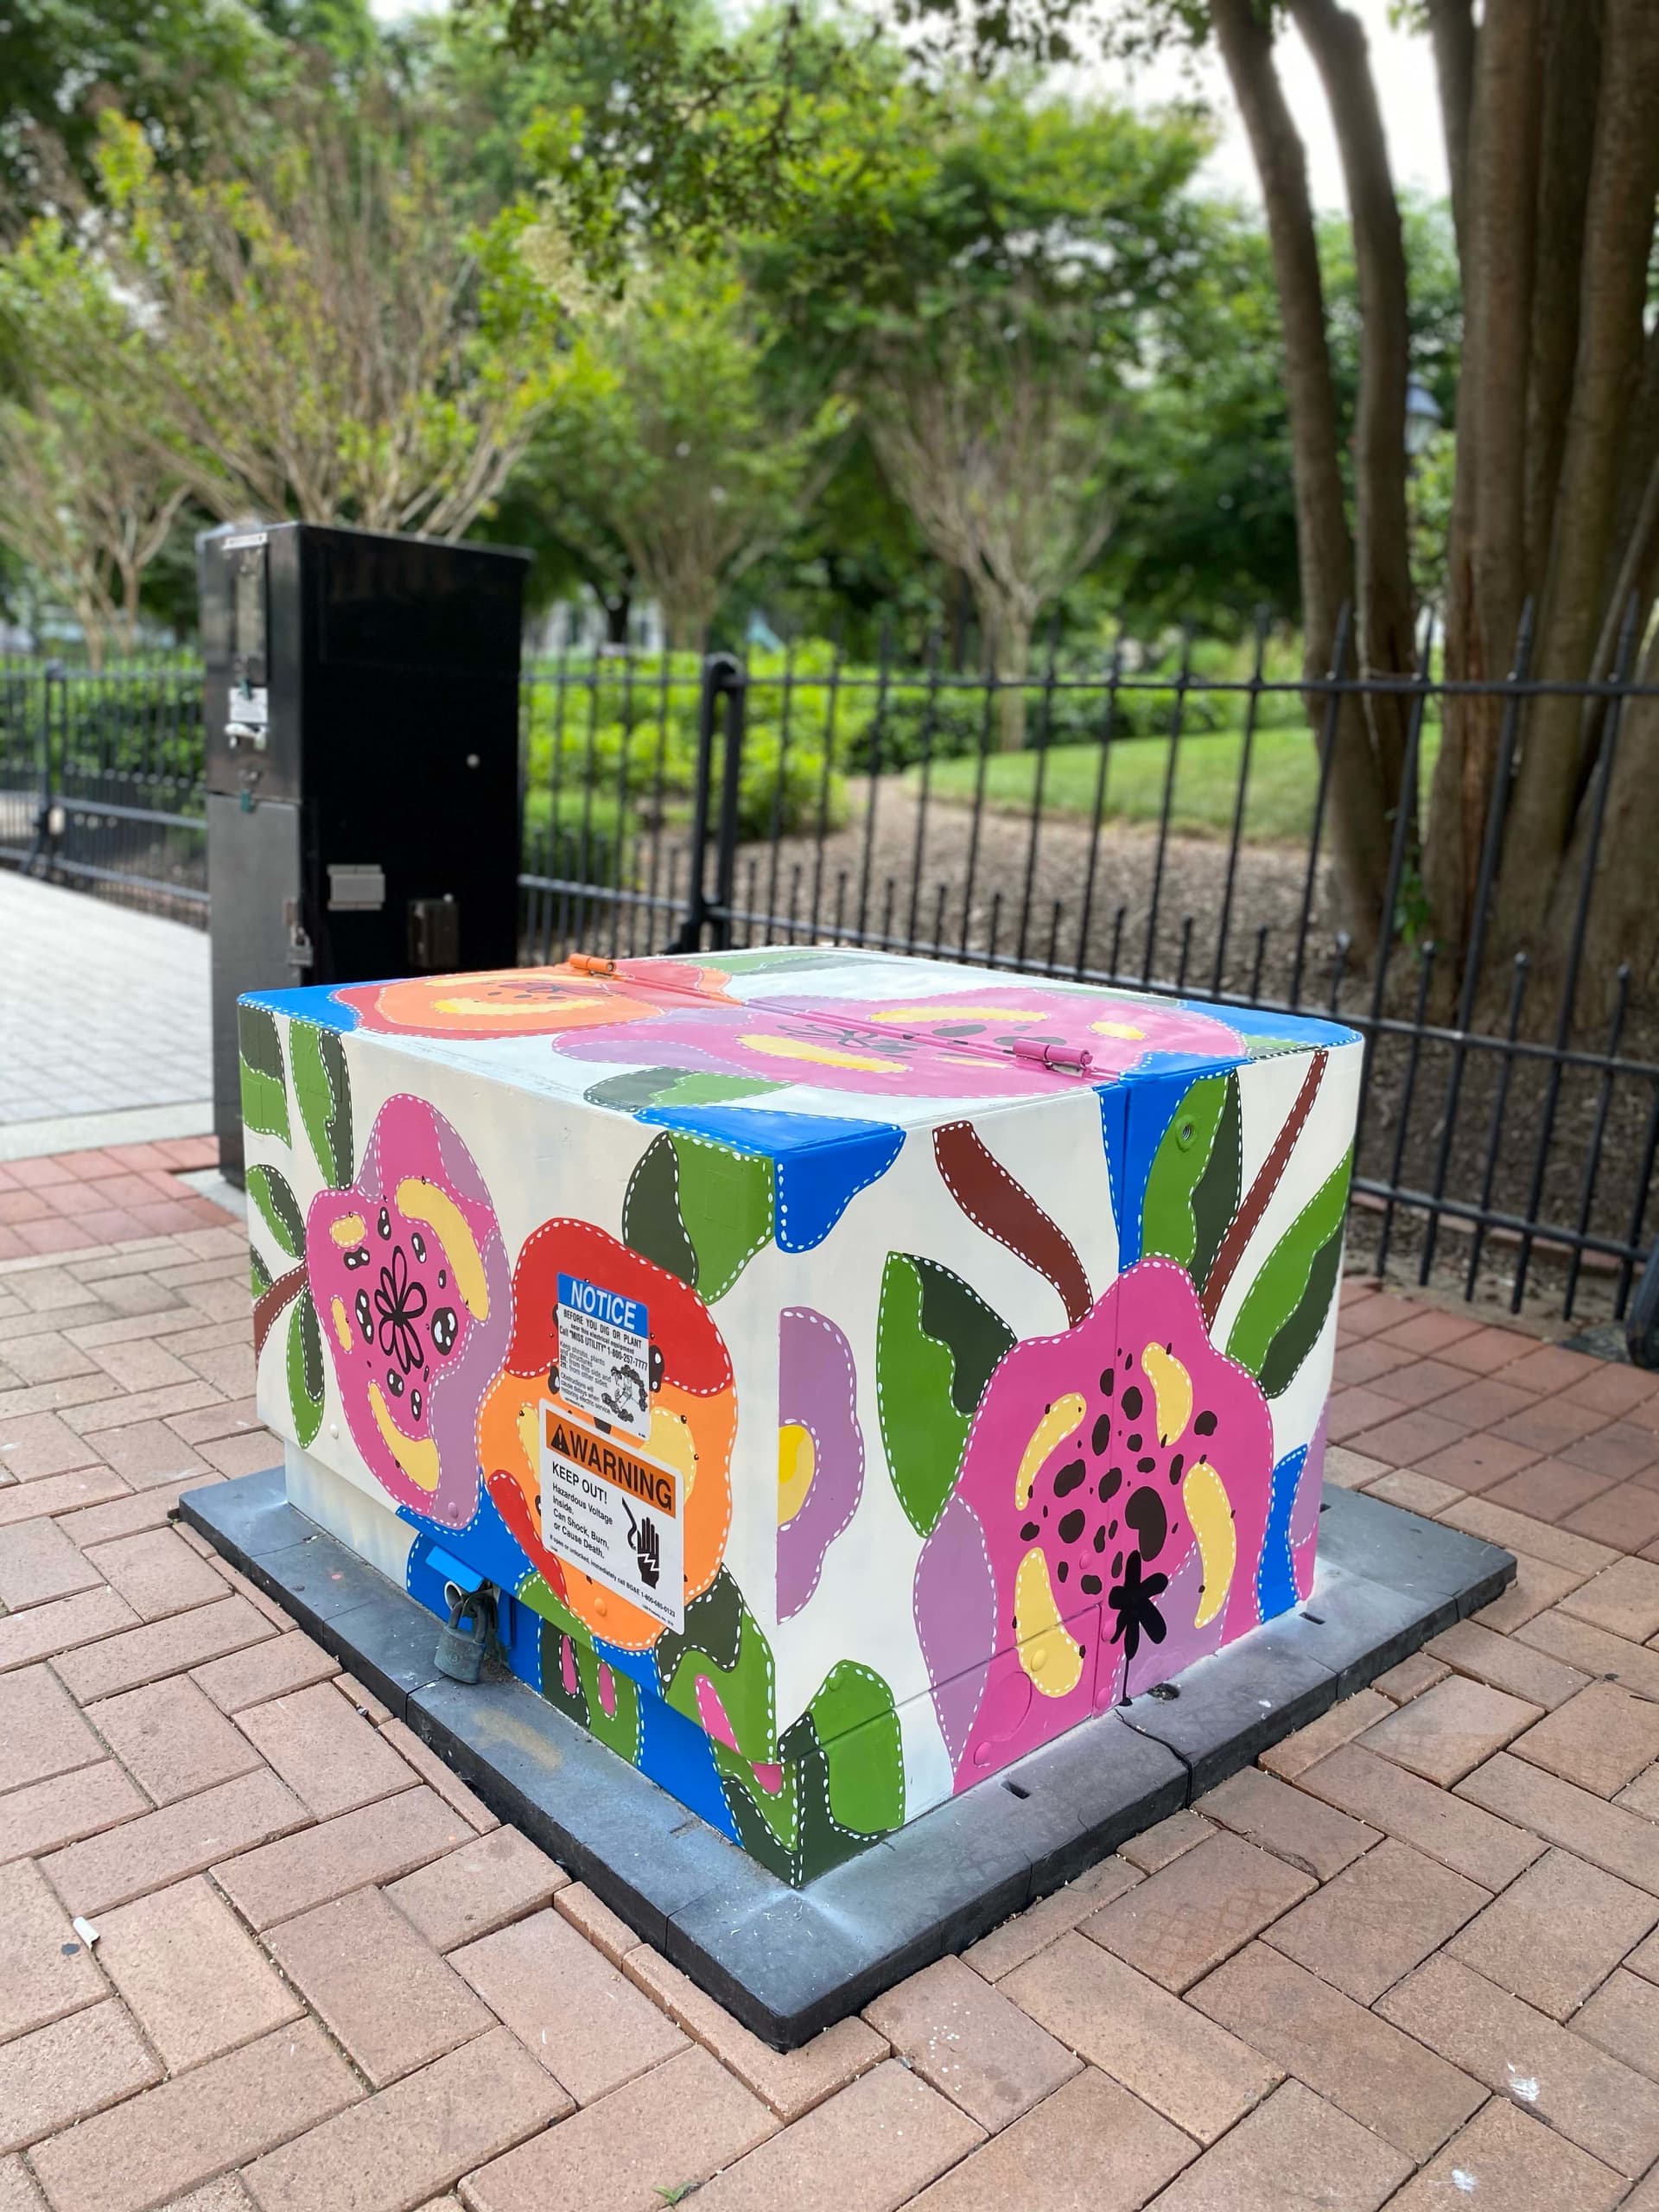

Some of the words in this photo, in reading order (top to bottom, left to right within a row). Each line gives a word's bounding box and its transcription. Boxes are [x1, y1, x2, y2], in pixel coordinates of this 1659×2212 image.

[571, 1281, 637, 1330] NOTICE
[560, 1325, 569, 1337] Call
[569, 1329, 584, 1344] "MISS
[585, 1336, 607, 1352] UTILITY"
[607, 1346, 648, 1371] 1-800-257-7777
[563, 1308, 584, 1325] BEFORE
[586, 1319, 598, 1331] YOU
[600, 1324, 610, 1336] DIG
[613, 1329, 621, 1340] OR
[623, 1334, 642, 1349] PLANT
[589, 1332, 610, 1344] electrical
[610, 1340, 634, 1354] equipment
[560, 1340, 570, 1351] Keep
[590, 1354, 605, 1366] plants
[569, 1352, 593, 1367] structures
[569, 1358, 580, 1369] from
[581, 1363, 591, 1373] this
[591, 1369, 601, 1378] side
[569, 1365, 580, 1376] from
[581, 1372, 594, 1382] other
[552, 1461, 579, 1486] KEEP
[582, 1479, 607, 1504] OUT!
[569, 1430, 671, 1510] WARNING
[553, 1483, 587, 1510] Hazardous
[588, 1503, 613, 1525] Voltage
[553, 1496, 574, 1515] Inside.
[553, 1508, 566, 1522] Can
[567, 1516, 589, 1538] Shock,
[591, 1531, 609, 1550] Burn,
[554, 1522, 560, 1531] or
[562, 1526, 582, 1545] Cause
[583, 1538, 605, 1559] Death.
[553, 1537, 564, 1548] open
[569, 1548, 590, 1564] unlocked,
[590, 1559, 617, 1581] immediately
[617, 1577, 626, 1586] call
[626, 1582, 640, 1596] BG&E
